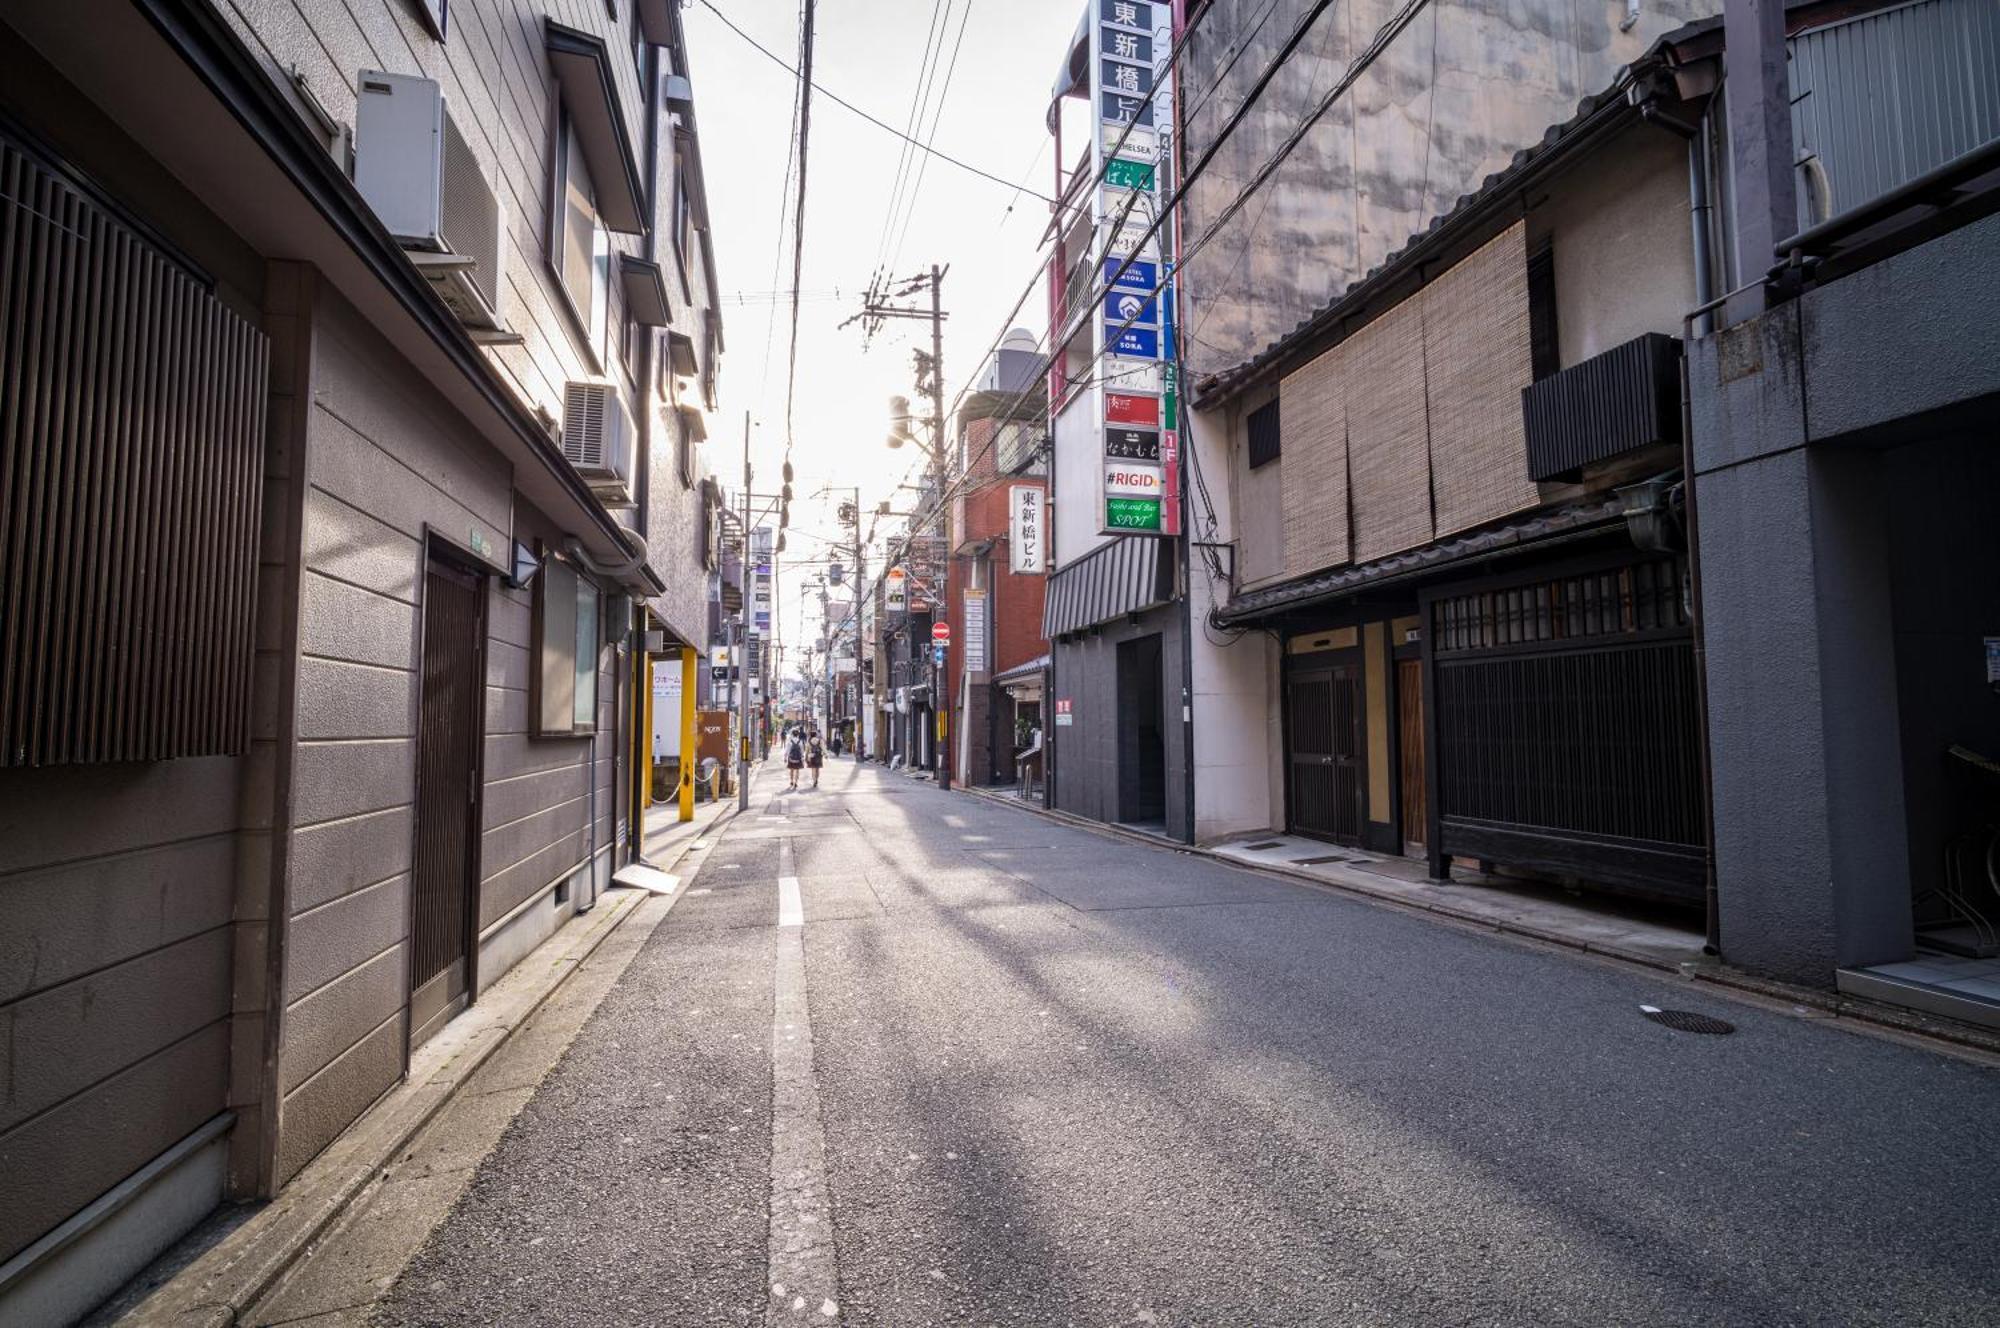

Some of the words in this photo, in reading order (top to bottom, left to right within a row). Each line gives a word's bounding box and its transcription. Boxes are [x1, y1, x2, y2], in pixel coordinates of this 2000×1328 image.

[1166, 435, 1176, 462] 1F
[1107, 472, 1153, 487] #RIGID
[1022, 491, 1036, 569] 東新橋ビル
